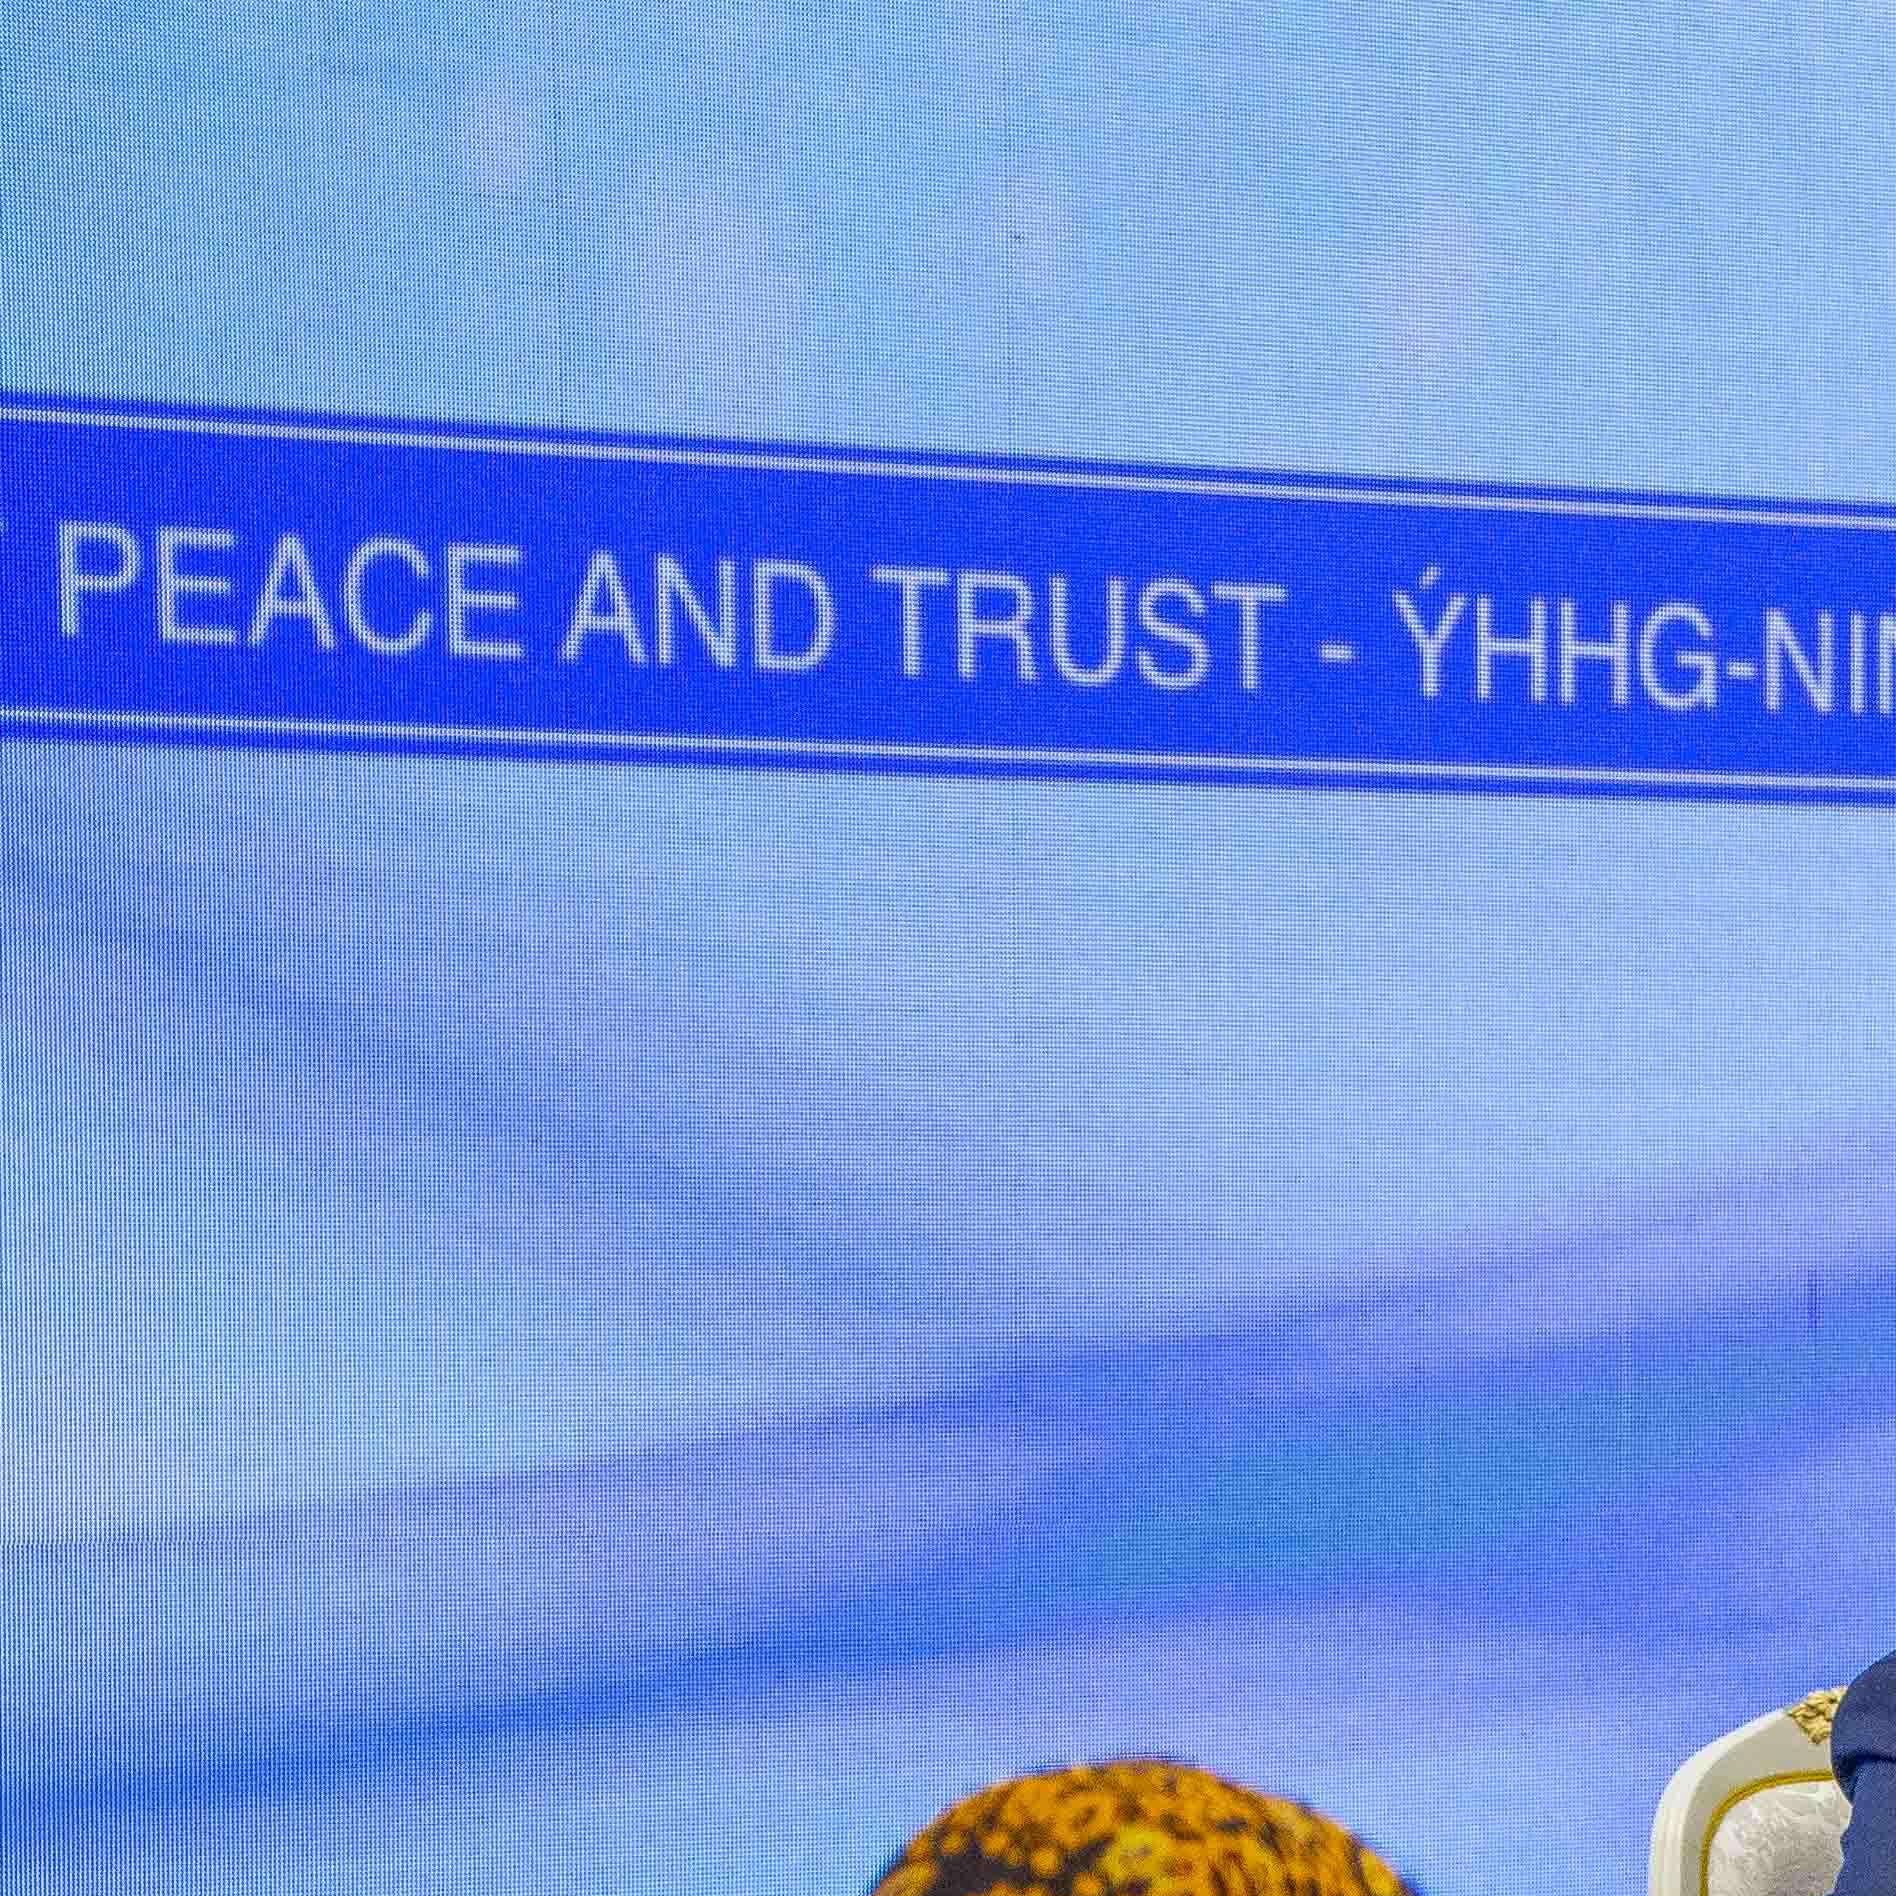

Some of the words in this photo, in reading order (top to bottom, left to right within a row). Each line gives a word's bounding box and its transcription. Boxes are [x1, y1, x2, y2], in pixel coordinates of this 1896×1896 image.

[58, 520, 524, 660] PEACE
[560, 550, 837, 673] AND
[869, 564, 1287, 691] TRUST
[1318, 640, 1355, 664] -
